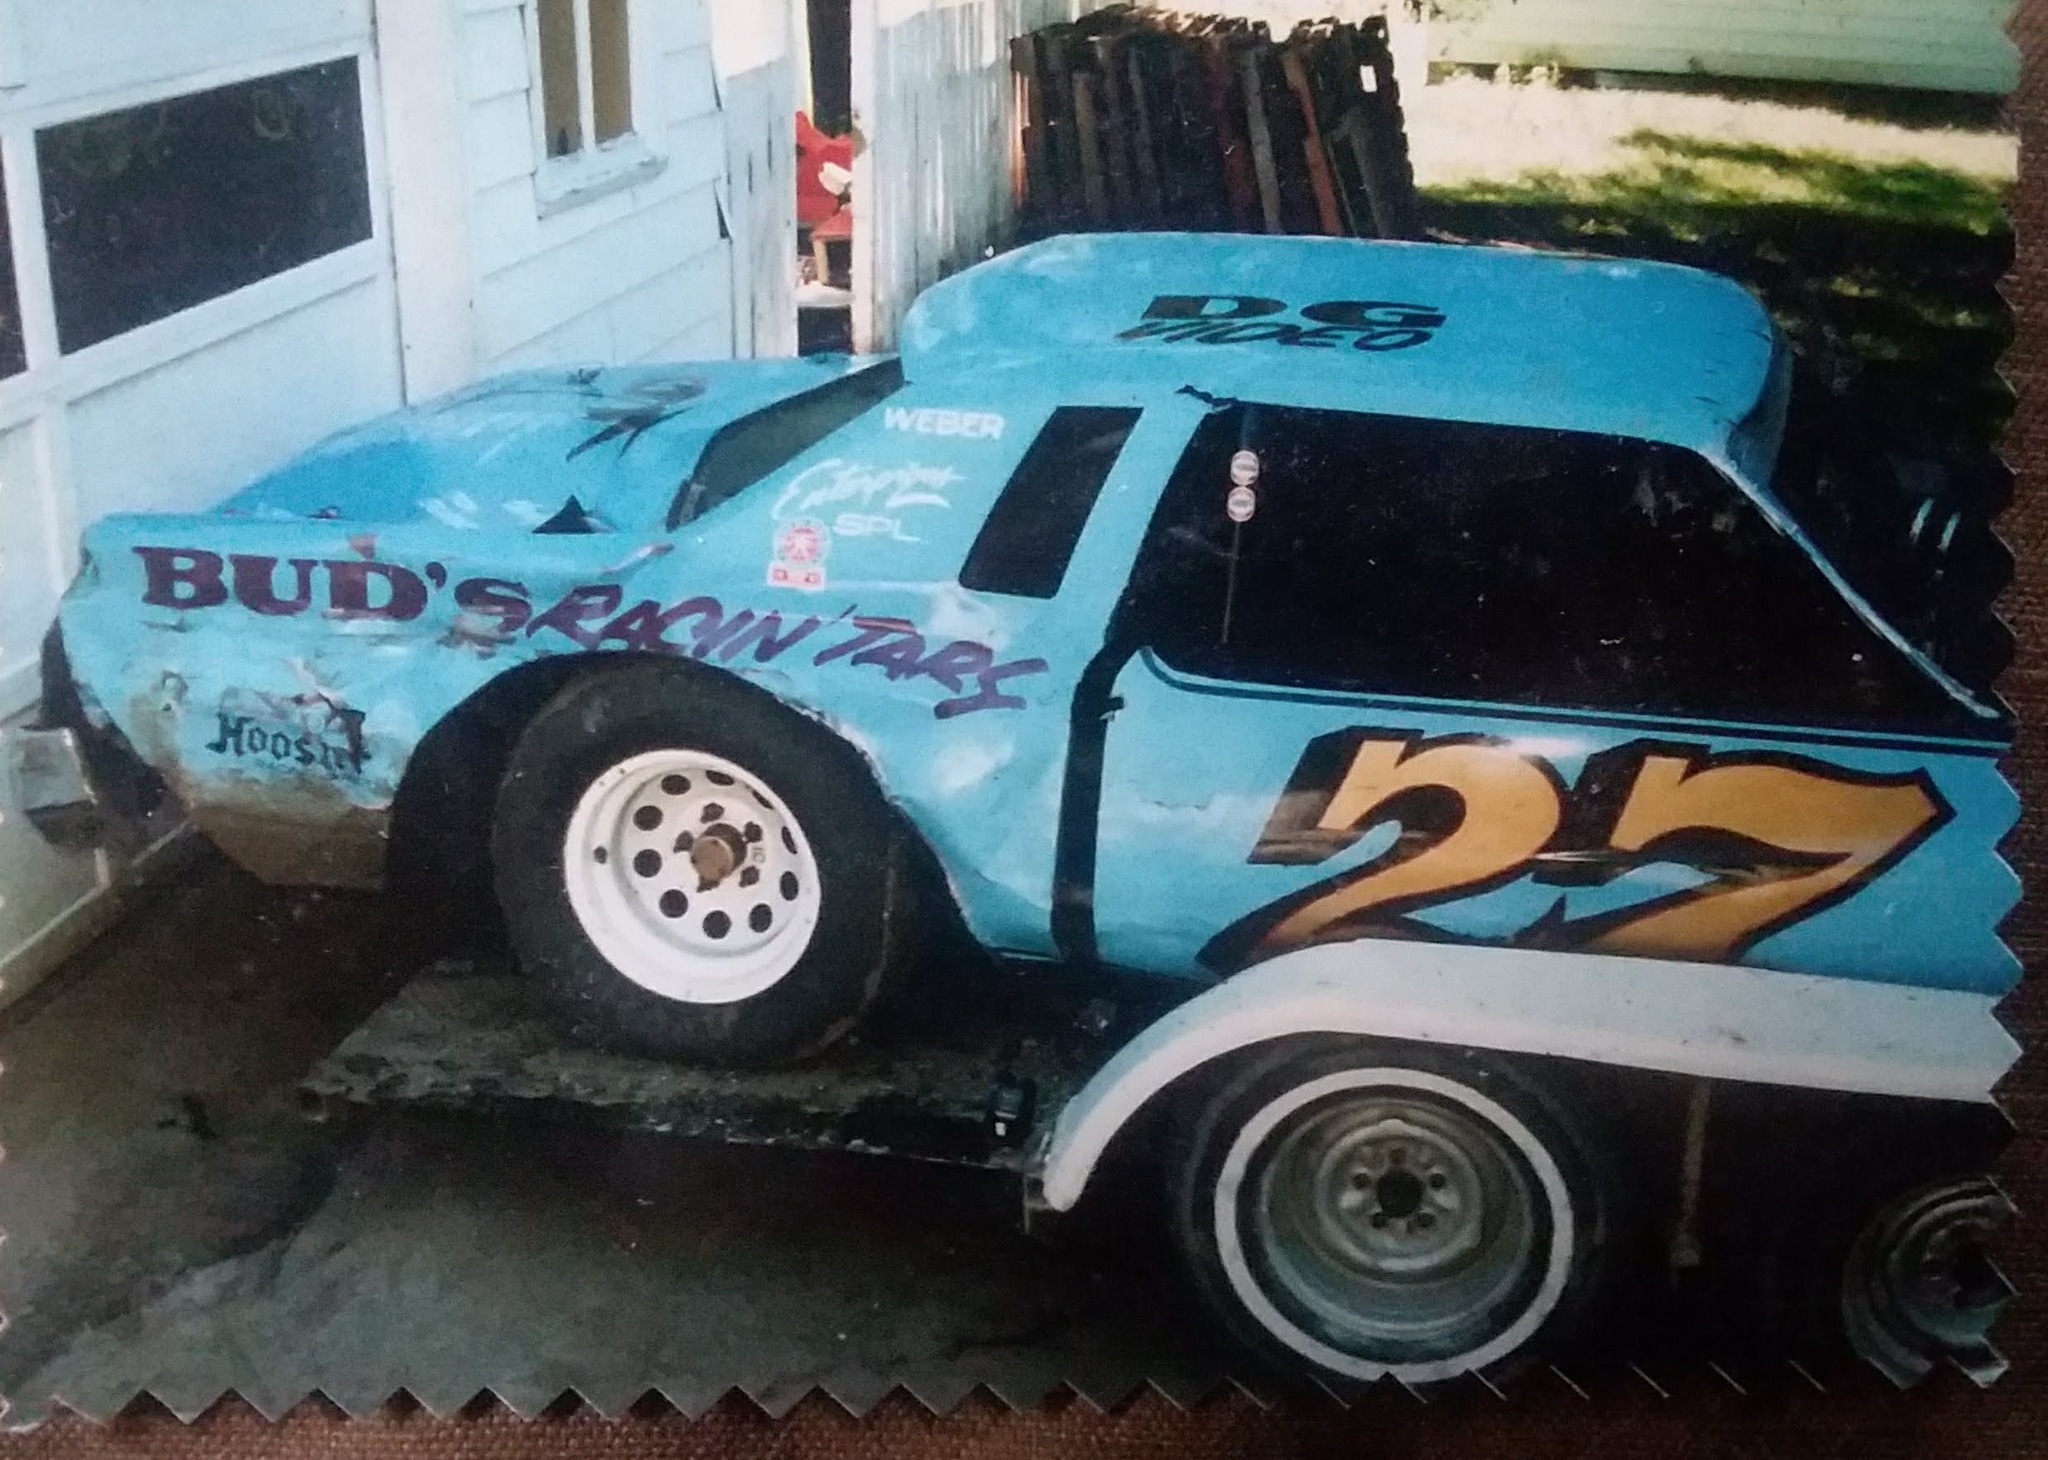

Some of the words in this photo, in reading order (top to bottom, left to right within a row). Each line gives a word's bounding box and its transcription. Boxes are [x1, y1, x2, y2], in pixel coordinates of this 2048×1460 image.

[1140, 295, 1447, 328] DG
[884, 407, 1006, 440] WEBER
[833, 513, 921, 542] SPL
[132, 546, 533, 655] BUD'S
[1196, 725, 1958, 977] 27
